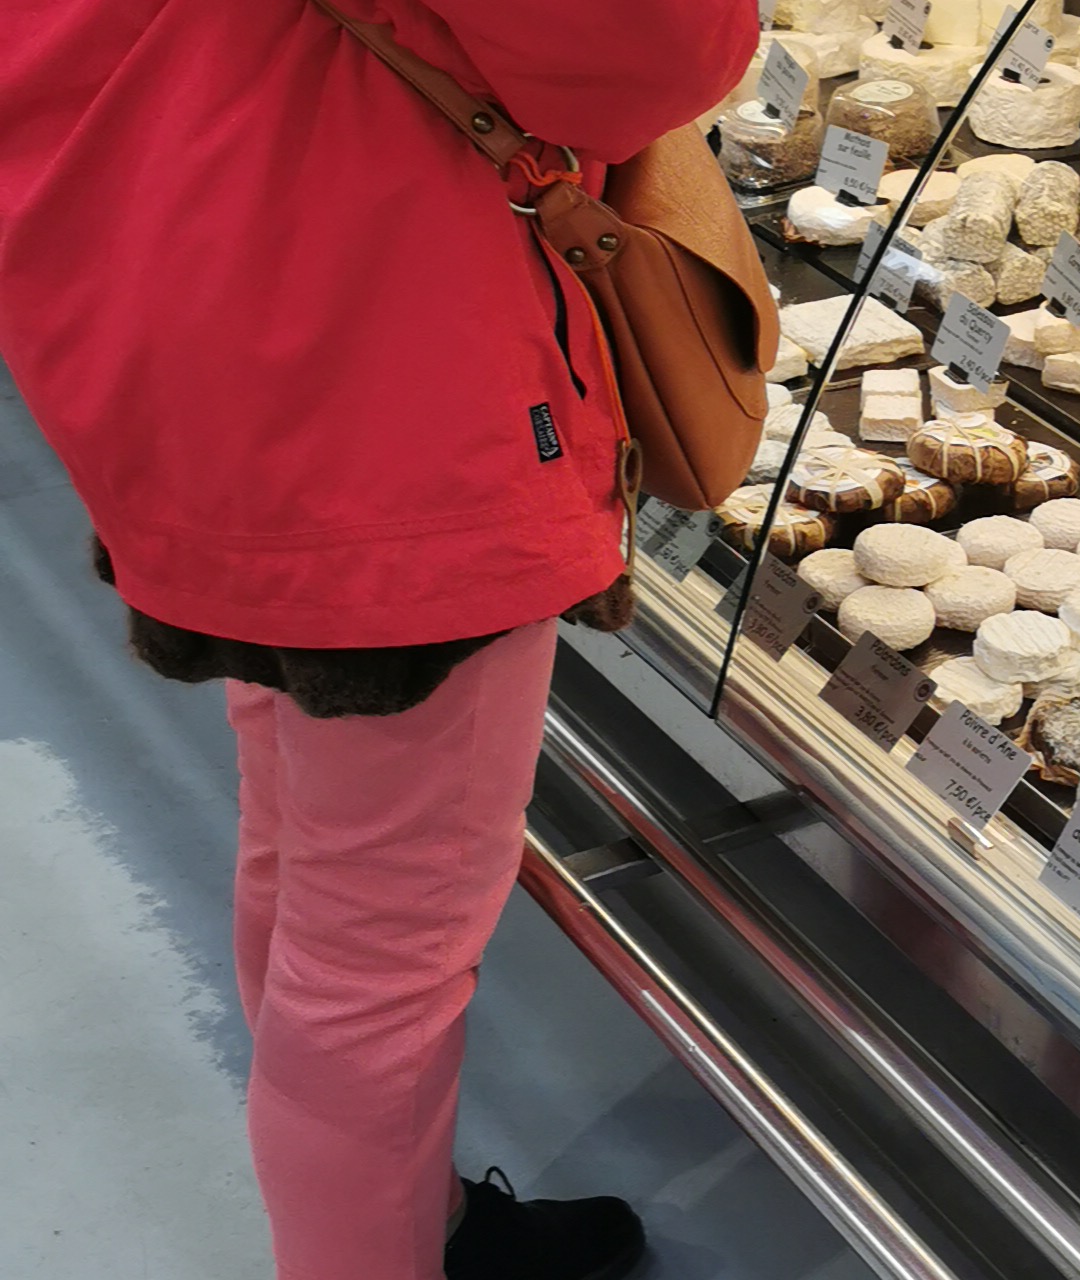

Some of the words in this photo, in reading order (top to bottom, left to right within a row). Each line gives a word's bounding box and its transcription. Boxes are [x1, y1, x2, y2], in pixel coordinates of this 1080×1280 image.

[539, 405, 558, 442] CAPTAIN
[959, 709, 990, 740] Poivre
[944, 778, 969, 802] 7,50
[965, 793, 993, 822] €/pce
